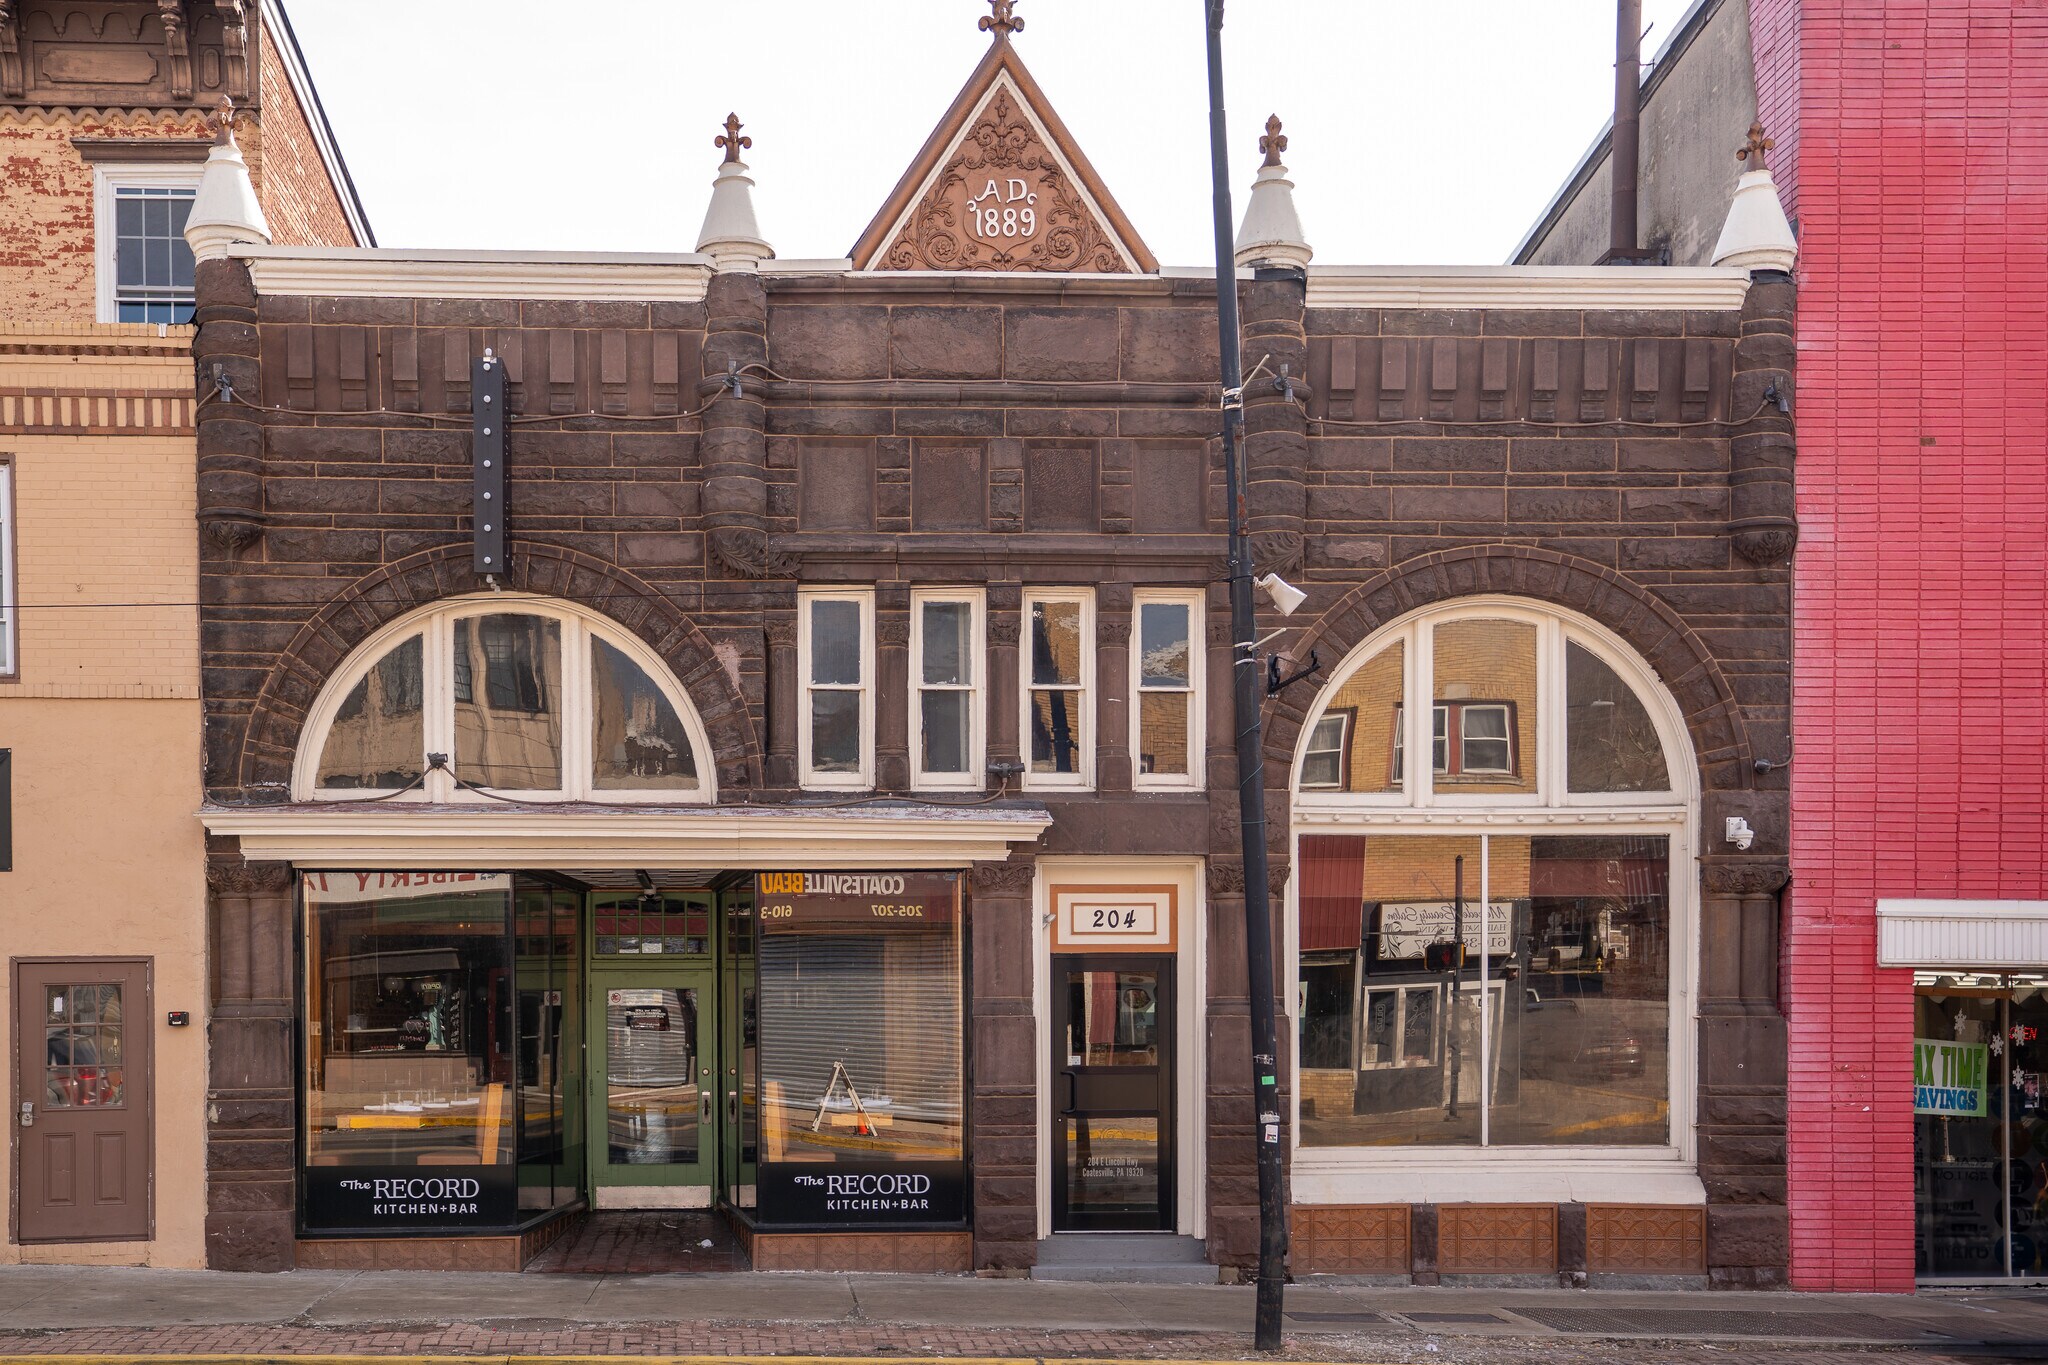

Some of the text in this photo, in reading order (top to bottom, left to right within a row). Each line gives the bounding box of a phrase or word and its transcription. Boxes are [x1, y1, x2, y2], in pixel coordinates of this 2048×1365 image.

[975, 208, 1036, 238] 1889
[1092, 909, 1137, 929] 204
[2008, 1026, 2038, 1040] OEN
[1914, 1044, 1984, 1089] AX TIME
[1105, 1157, 1125, 1166] Lincoln
[1127, 1157, 1139, 1168] Hwy
[1116, 1168, 1124, 1177] PA
[1126, 1167, 1144, 1177] 19320
[339, 1178, 480, 1199] The RECORD
[794, 1174, 931, 1195] The RECORD
[374, 1203, 479, 1214] KITCHEN+BAR
[827, 1199, 929, 1210] KITCHEN+BAR
